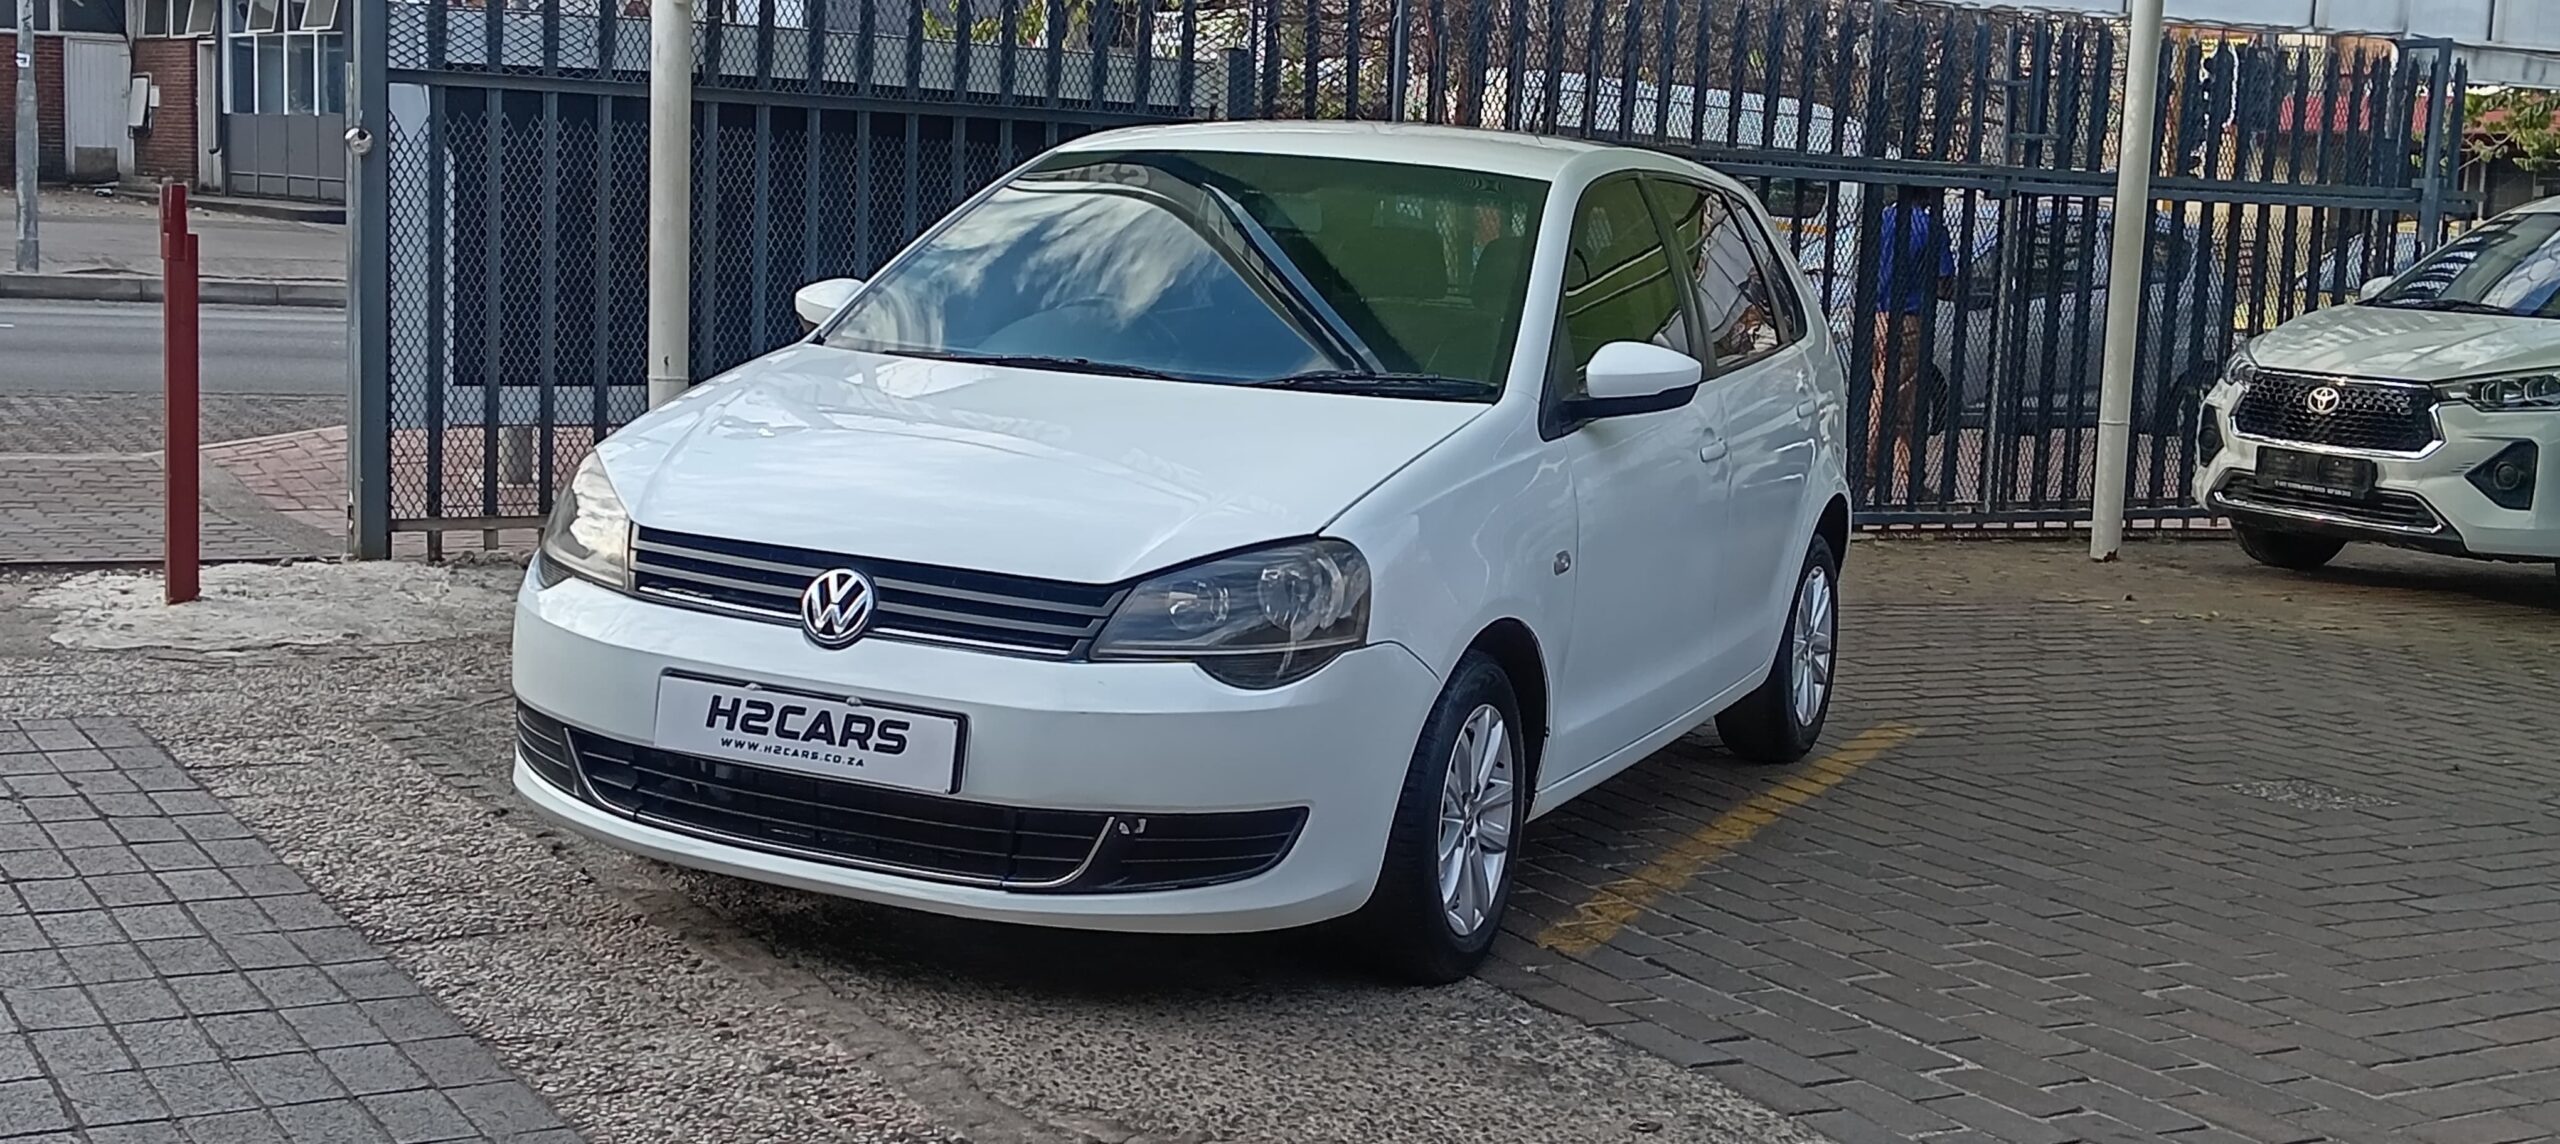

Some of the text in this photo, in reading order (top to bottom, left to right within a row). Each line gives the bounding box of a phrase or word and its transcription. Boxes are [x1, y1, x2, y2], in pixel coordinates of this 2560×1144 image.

[802, 568, 874, 642] VW
[705, 695, 911, 755] H2CARS
[720, 737, 865, 768] WWW.H2CARS.CO.ZA
